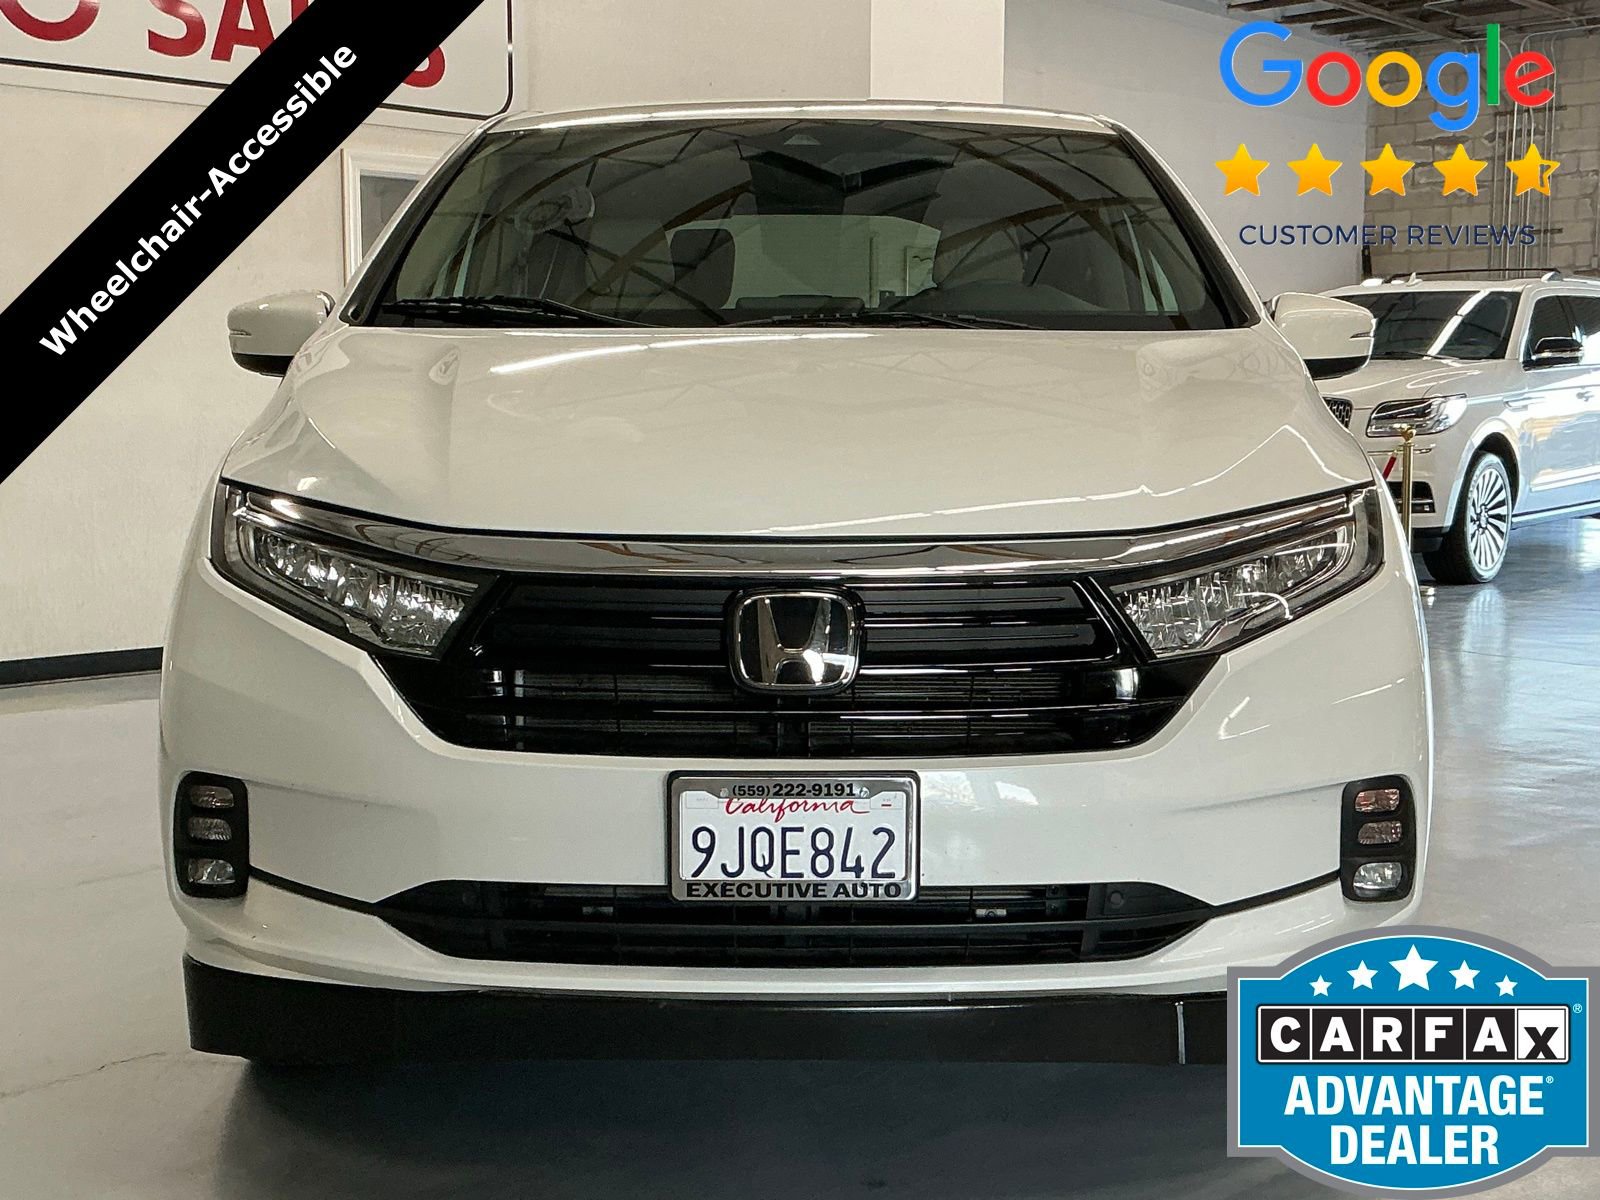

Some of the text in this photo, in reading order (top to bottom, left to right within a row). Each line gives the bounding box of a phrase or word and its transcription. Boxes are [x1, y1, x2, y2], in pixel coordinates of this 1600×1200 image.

[732, 783, 855, 798] (559) 222-9191
[725, 798, 870, 823] California
[691, 826, 896, 879] 9JQE842
[686, 882, 901, 898] EXECUTIVE AUTO
